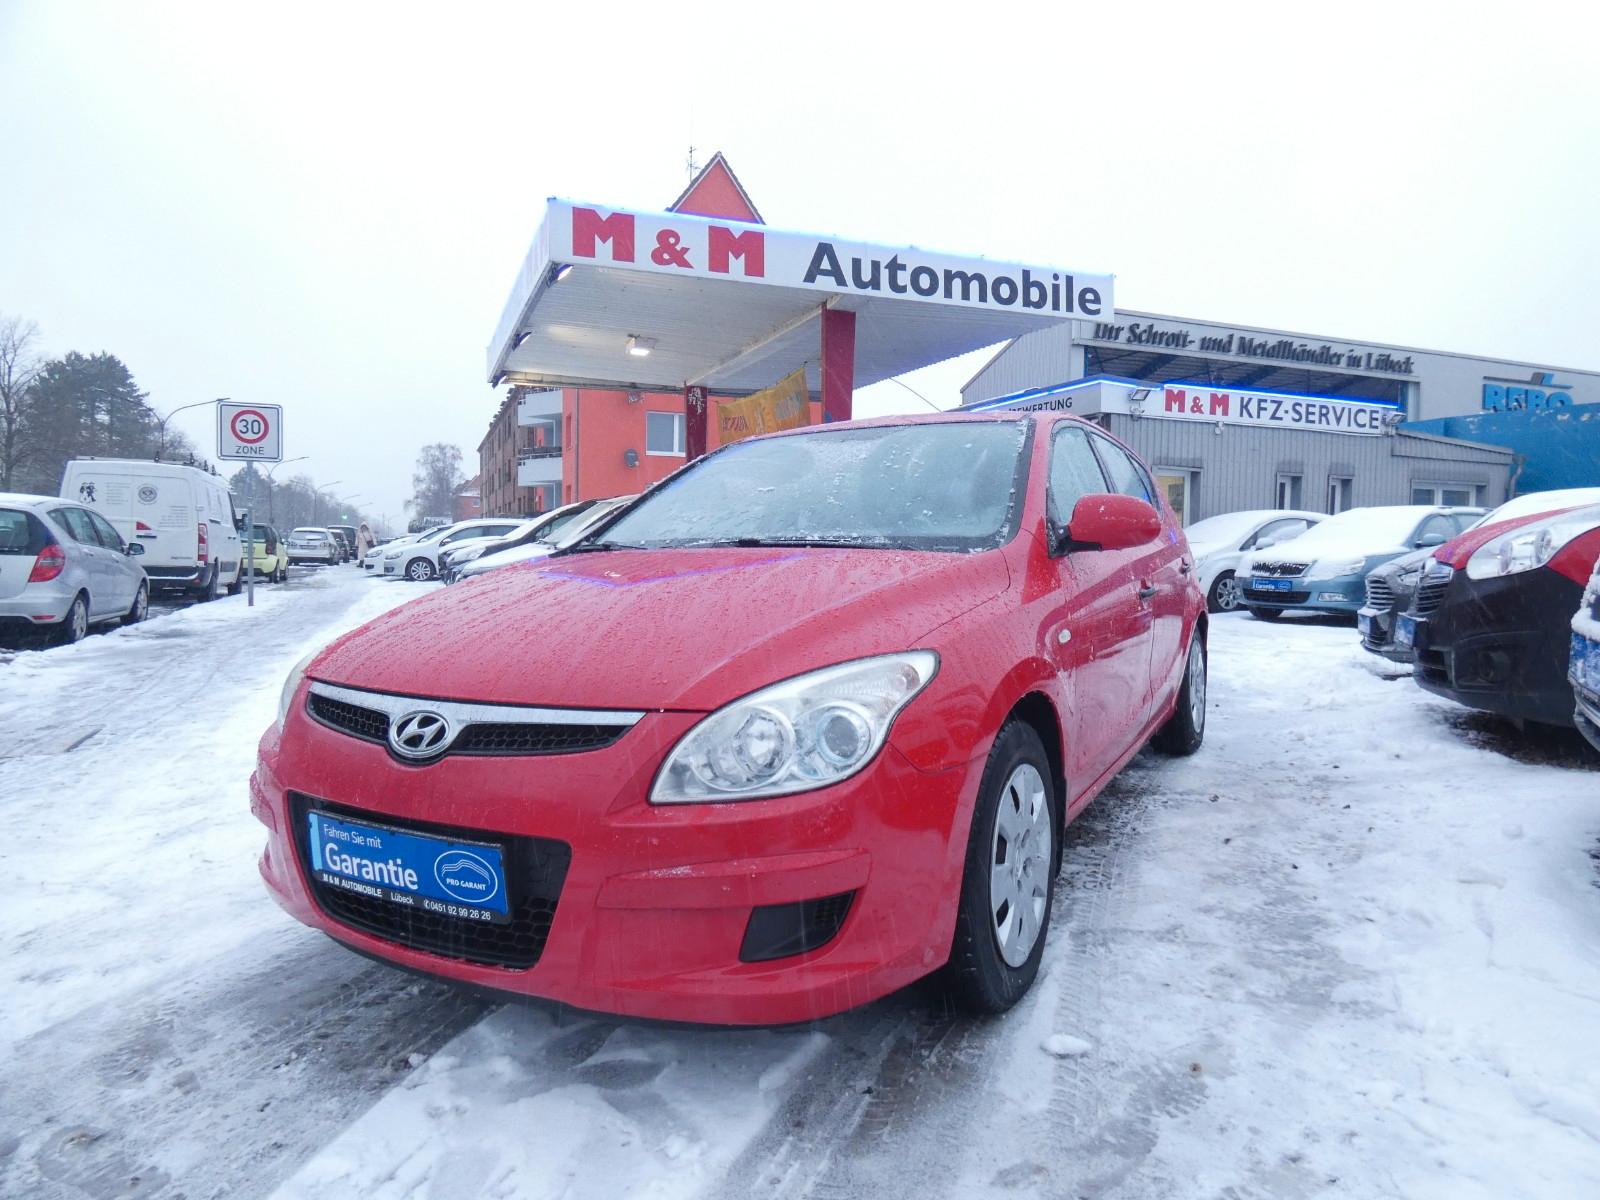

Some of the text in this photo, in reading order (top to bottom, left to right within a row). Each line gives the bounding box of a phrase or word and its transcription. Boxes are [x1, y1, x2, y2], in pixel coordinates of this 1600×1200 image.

[572, 206, 1102, 317] M & M Automobile
[1200, 332, 1235, 353] und
[1237, 336, 1345, 366] Metallhändler
[1346, 348, 1363, 368] in
[1364, 351, 1415, 374] Lübeck
[239, 418, 261, 435] 30
[1164, 388, 1380, 430] M & M KFZ-SERVICE
[235, 445, 265, 455] ZONE
[323, 823, 383, 849] Fahren Sie mit
[325, 842, 419, 890] Garantie
[446, 877, 487, 891] PRO GARANT
[323, 873, 329, 882] M
[329, 875, 334, 884] &
[334, 876, 340, 886] M
[341, 879, 383, 898] AUTOMOBILE
[430, 901, 446, 913] 0451
[447, 906, 458, 915] 92
[469, 909, 480, 919] 26
[481, 910, 491, 921] 26
